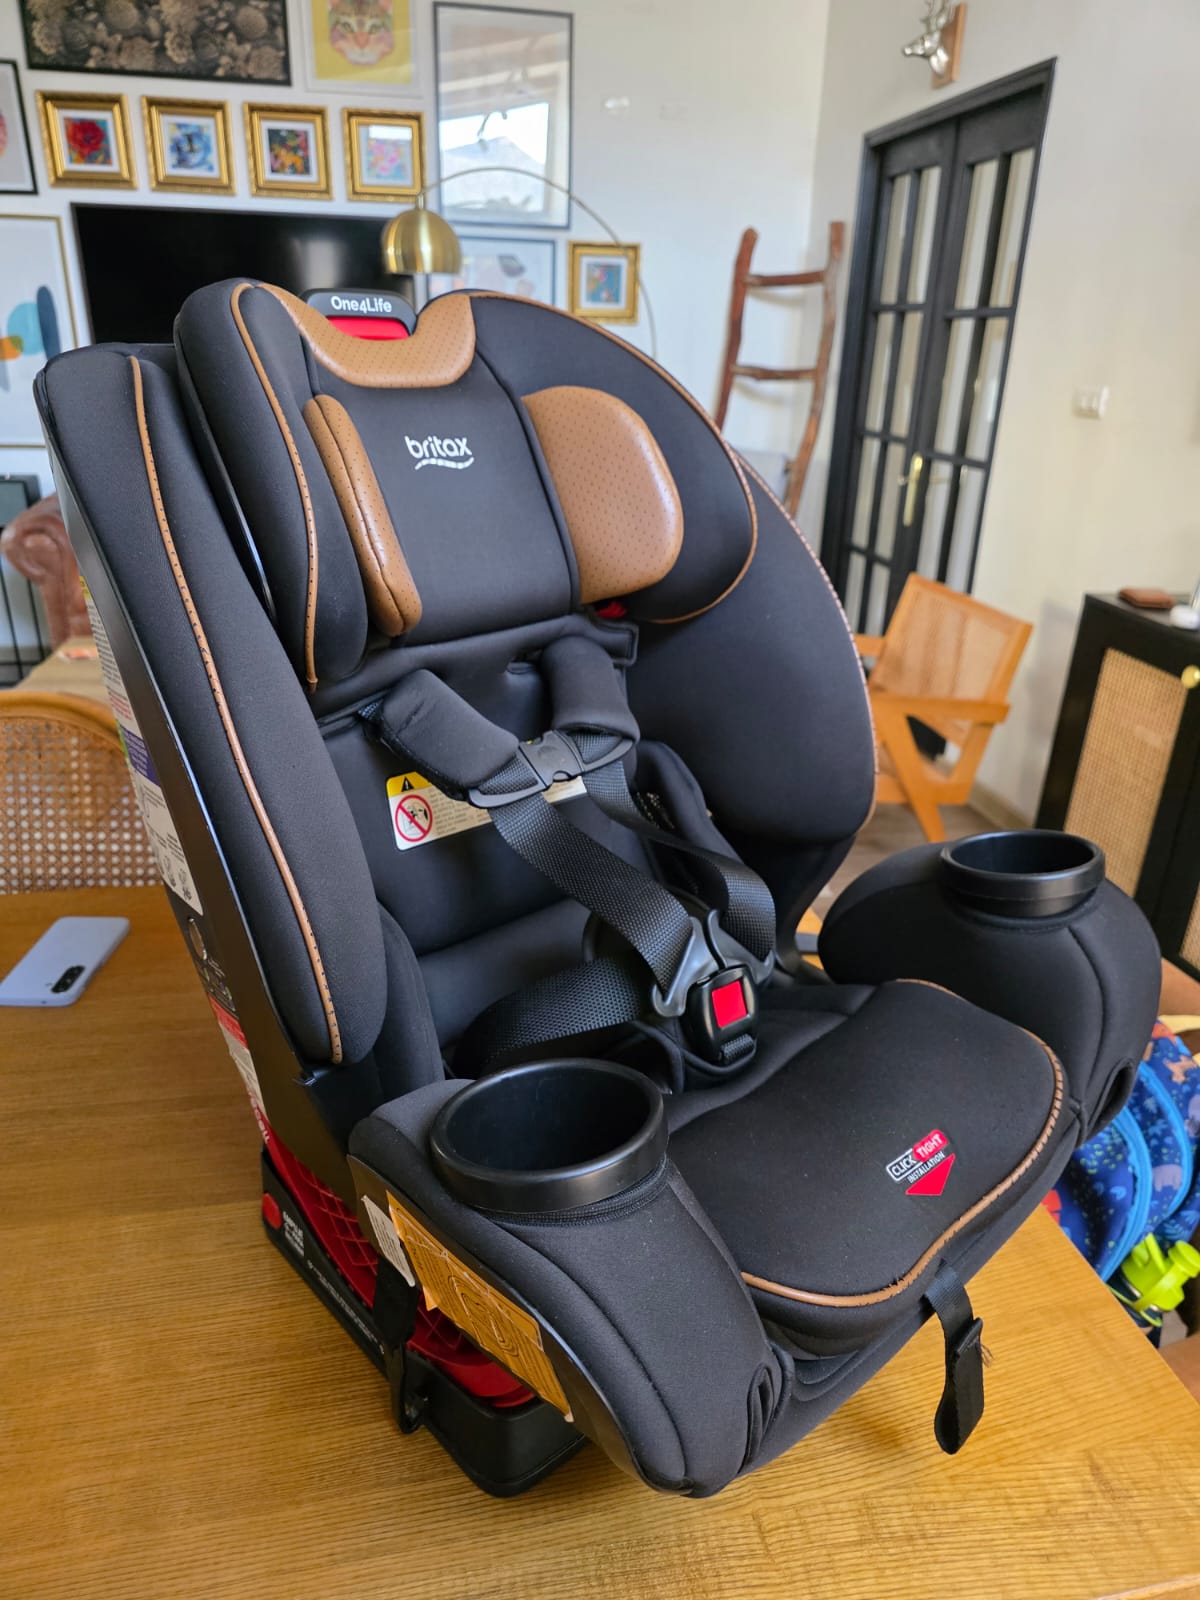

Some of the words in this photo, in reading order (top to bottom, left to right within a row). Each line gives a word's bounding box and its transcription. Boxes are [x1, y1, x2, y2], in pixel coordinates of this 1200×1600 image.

[330, 295, 393, 314] One4Life
[404, 435, 473, 459] britax
[891, 1154, 917, 1176] CLICK
[916, 1133, 943, 1158] TIGHT
[907, 1150, 946, 1184] INSTALLATION
